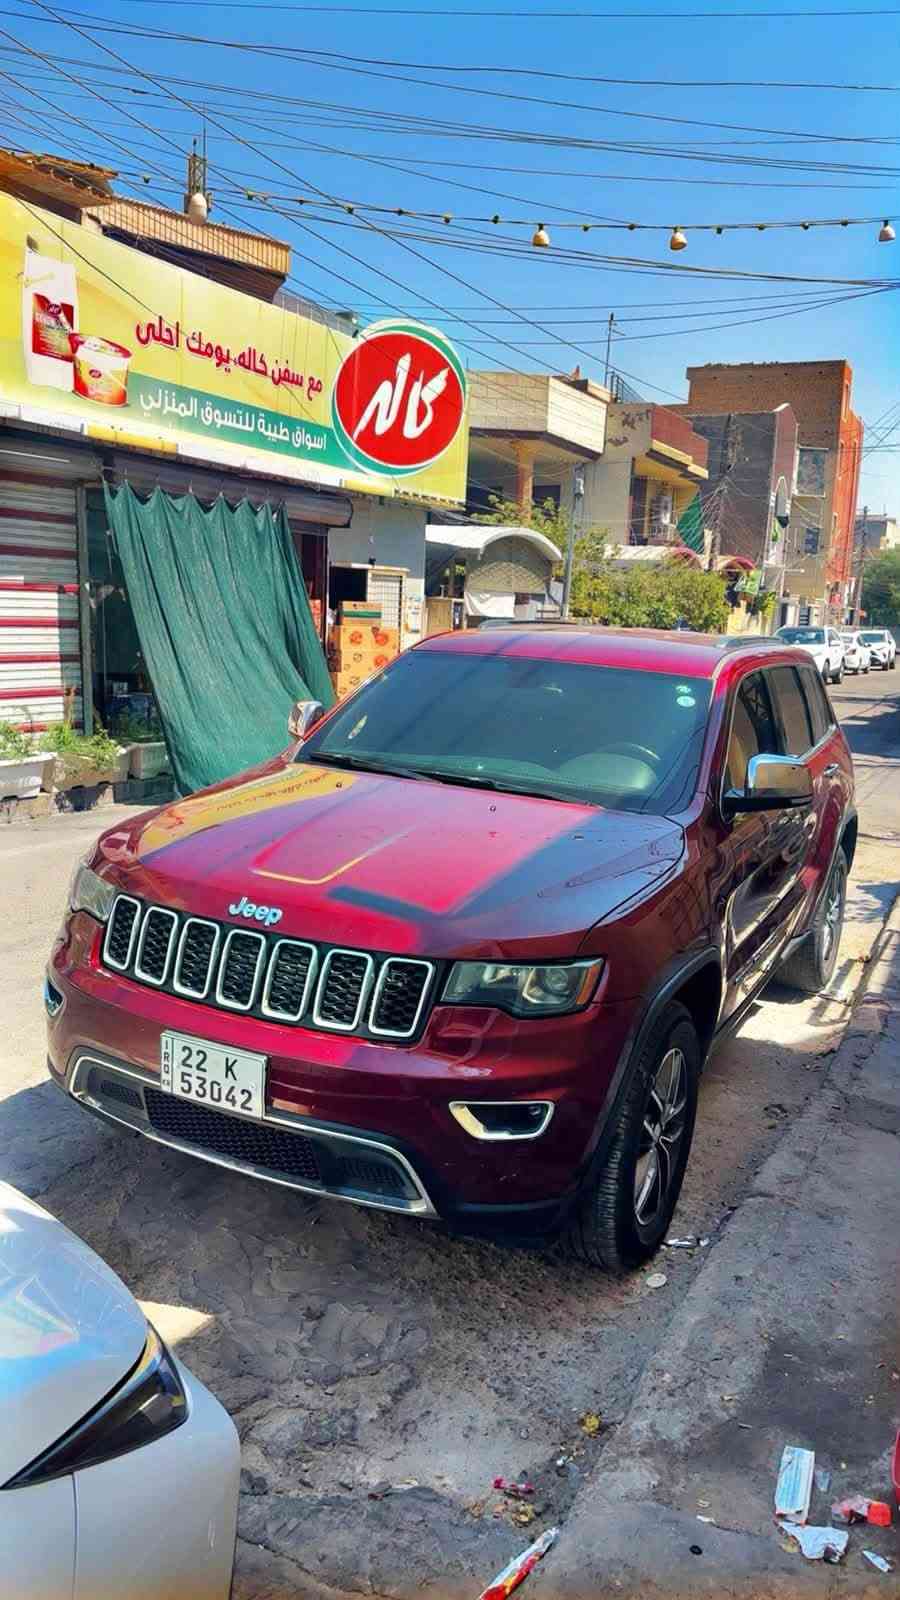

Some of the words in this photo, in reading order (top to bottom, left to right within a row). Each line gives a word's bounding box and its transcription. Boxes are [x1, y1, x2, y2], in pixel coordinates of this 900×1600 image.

[136, 315, 180, 348] احلى
[186, 331, 231, 373] يومك
[272, 360, 304, 386] سفن
[307, 376, 323, 401] مع
[140, 388, 198, 418] المنزلي
[353, 352, 450, 440] كاله
[201, 400, 255, 432] للتسوق
[257, 413, 290, 441] طيبة
[292, 426, 327, 450] اسواق
[229, 896, 283, 926] Jeep
[181, 1045, 208, 1073] 22
[225, 1057, 238, 1081] K
[180, 1072, 253, 1112] 53042
